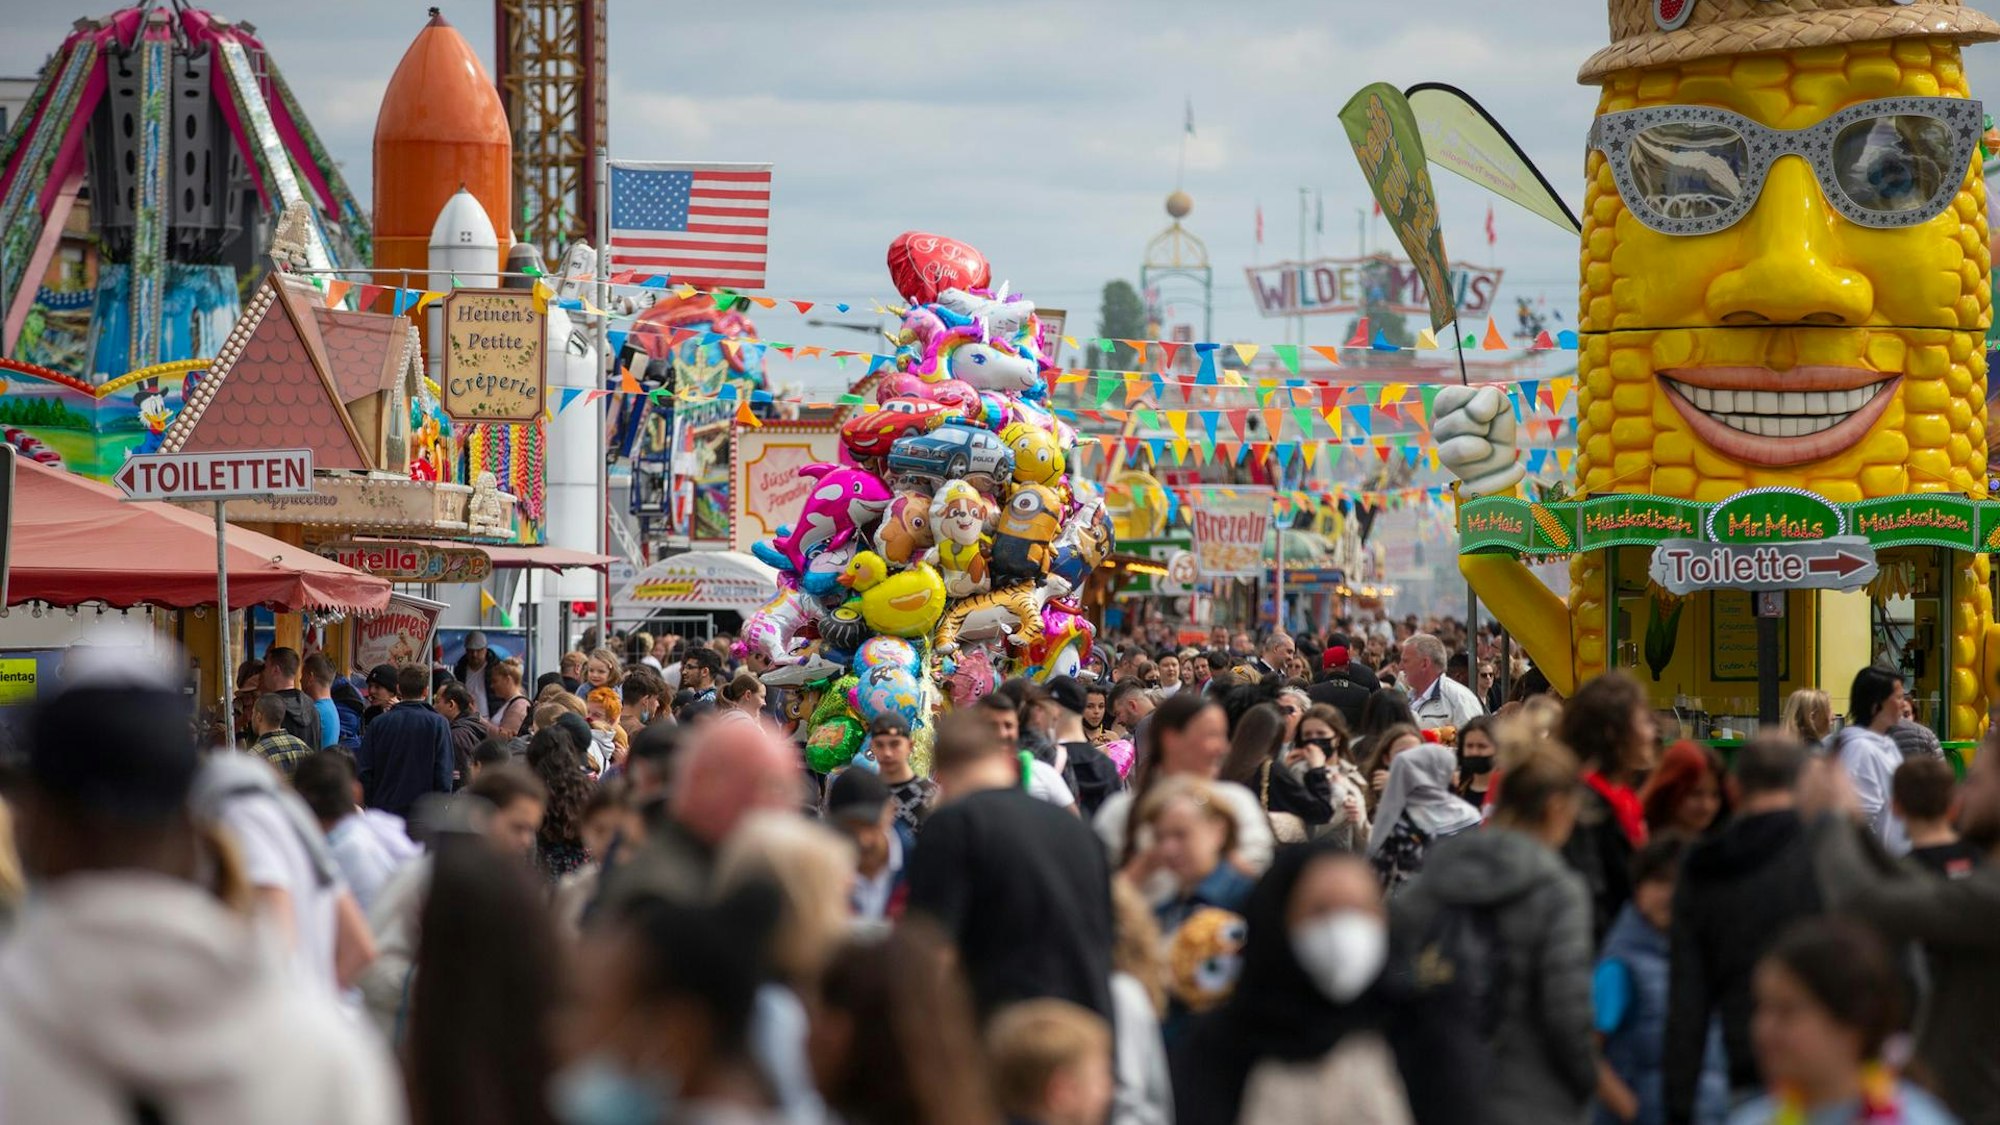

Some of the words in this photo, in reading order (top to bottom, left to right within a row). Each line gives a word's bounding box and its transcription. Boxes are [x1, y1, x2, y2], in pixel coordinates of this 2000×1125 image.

[922, 260, 958, 284] You
[1256, 267, 1352, 310] WILDE
[1391, 266, 1492, 311] MUS
[457, 304, 535, 323] Heinen's
[468, 333, 523, 350] Petite
[450, 372, 537, 399] Crêperie
[972, 455, 995, 463] POLICE
[138, 457, 306, 493] TOILETTEN
[253, 493, 338, 510] appuccino
[1196, 511, 1267, 544] Brezeln
[1586, 508, 1694, 534] Maiskolben
[1858, 508, 1969, 534] Maiskolben
[1667, 548, 1804, 583] Toilette
